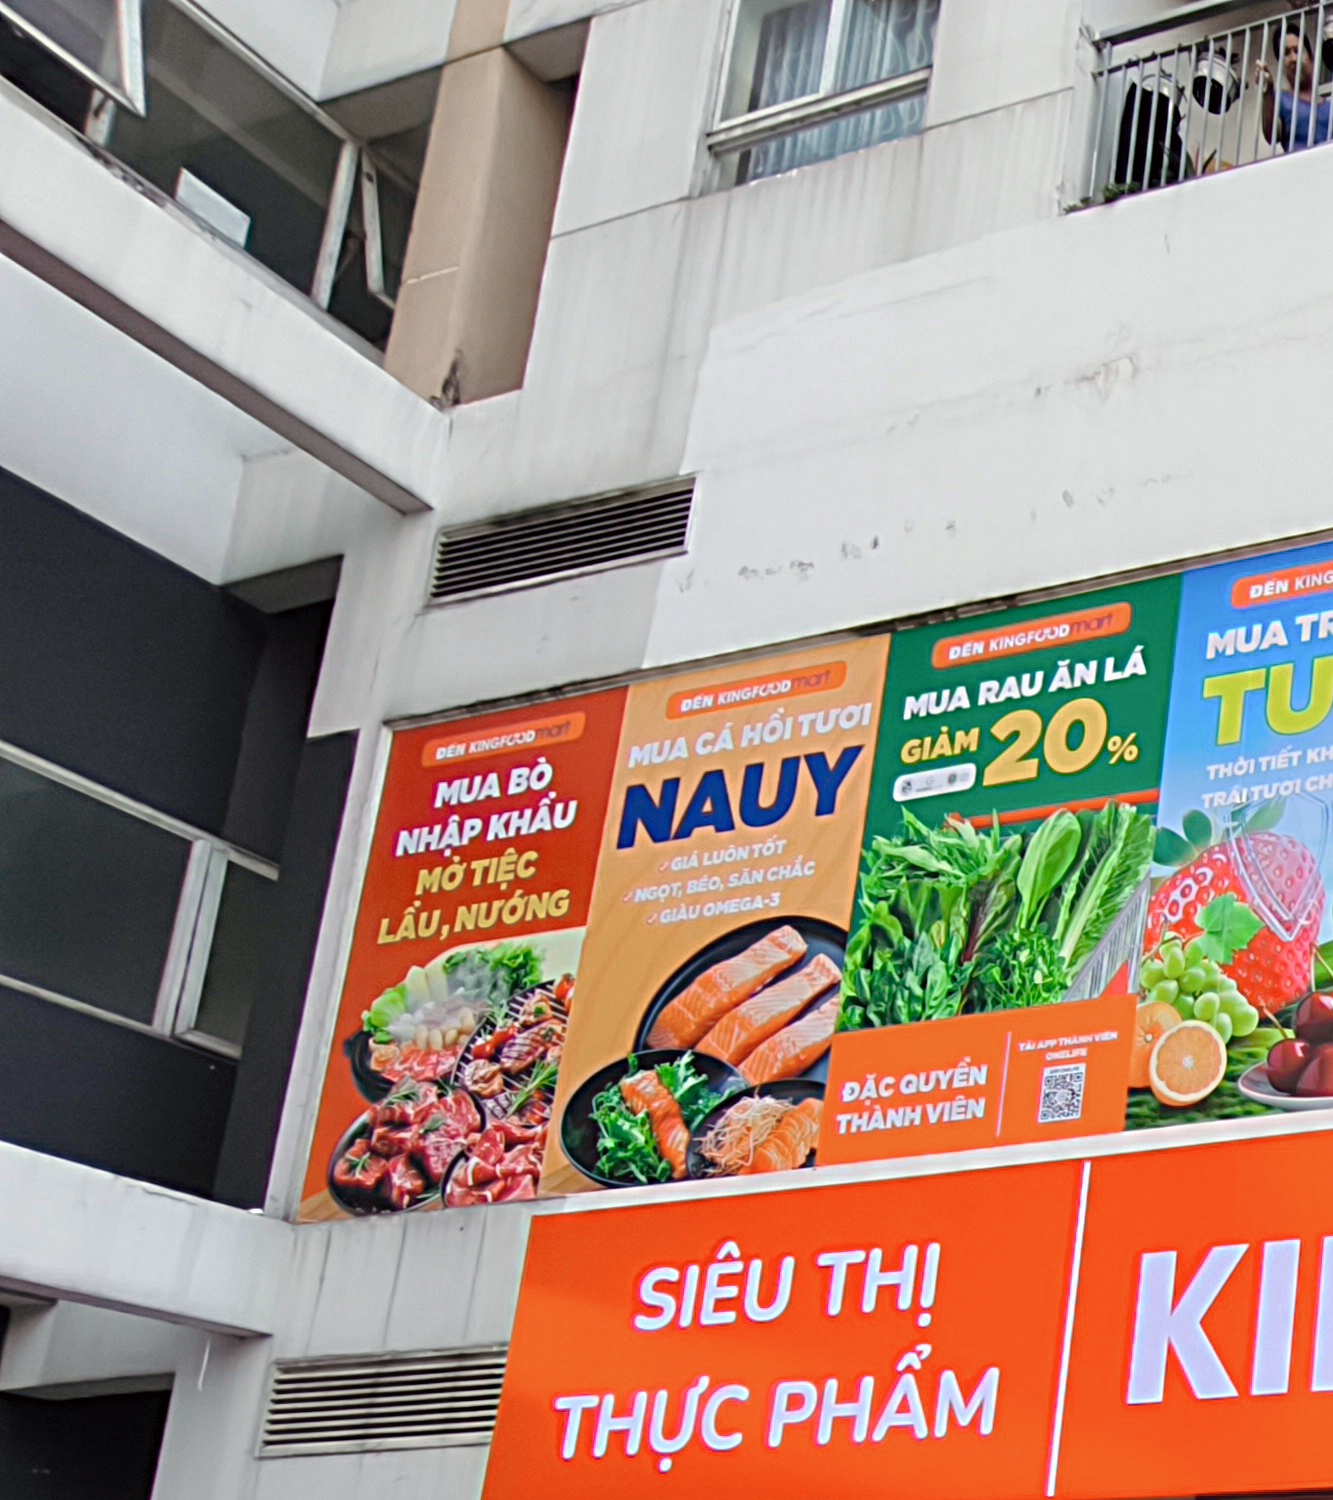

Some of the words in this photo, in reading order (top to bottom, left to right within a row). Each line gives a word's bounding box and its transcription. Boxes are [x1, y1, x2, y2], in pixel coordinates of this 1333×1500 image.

[1205, 621, 1288, 660] MUA
[903, 686, 970, 721] MUA
[977, 671, 1044, 706] RAU
[1048, 659, 1098, 693] ĂN
[1103, 646, 1147, 682] LÁ
[628, 738, 689, 768] MUA
[696, 723, 734, 755] CÁ
[741, 708, 792, 747] HỒI
[798, 702, 872, 737] TƯƠI
[900, 727, 980, 764] GIẢM
[983, 697, 1139, 787] 20%
[434, 772, 500, 808] MUA
[508, 757, 553, 795] BÒ
[1206, 755, 1256, 781] THỜI
[1258, 746, 1302, 772] TIẾT
[616, 744, 865, 849] NAUY
[1250, 780, 1302, 801] TƯƠI
[395, 815, 482, 857] NHẬP
[487, 792, 577, 841] KHẨU
[415, 856, 466, 896] MỞ
[470, 848, 538, 890] TIỆC
[671, 848, 698, 871] GIÁ
[703, 845, 749, 867] LUÔN
[752, 835, 787, 856] TỐT
[634, 882, 683, 904] NGỌT,
[686, 872, 724, 895] BÉO,
[660, 901, 700, 924] GIÀU
[703, 893, 781, 917] OMEGA-3
[377, 900, 450, 944] LẨU,
[454, 889, 570, 932] NƯỚNG
[842, 1074, 895, 1106] ĐẶC
[899, 1057, 988, 1094] QUYỀN
[836, 1104, 922, 1135] THÀNH
[926, 1096, 986, 1125] VIÊN
[632, 1241, 796, 1332] SIÊU
[816, 1242, 941, 1329] THỊ
[554, 1375, 750, 1473] THỰC
[766, 1343, 1001, 1449] PHẨM
